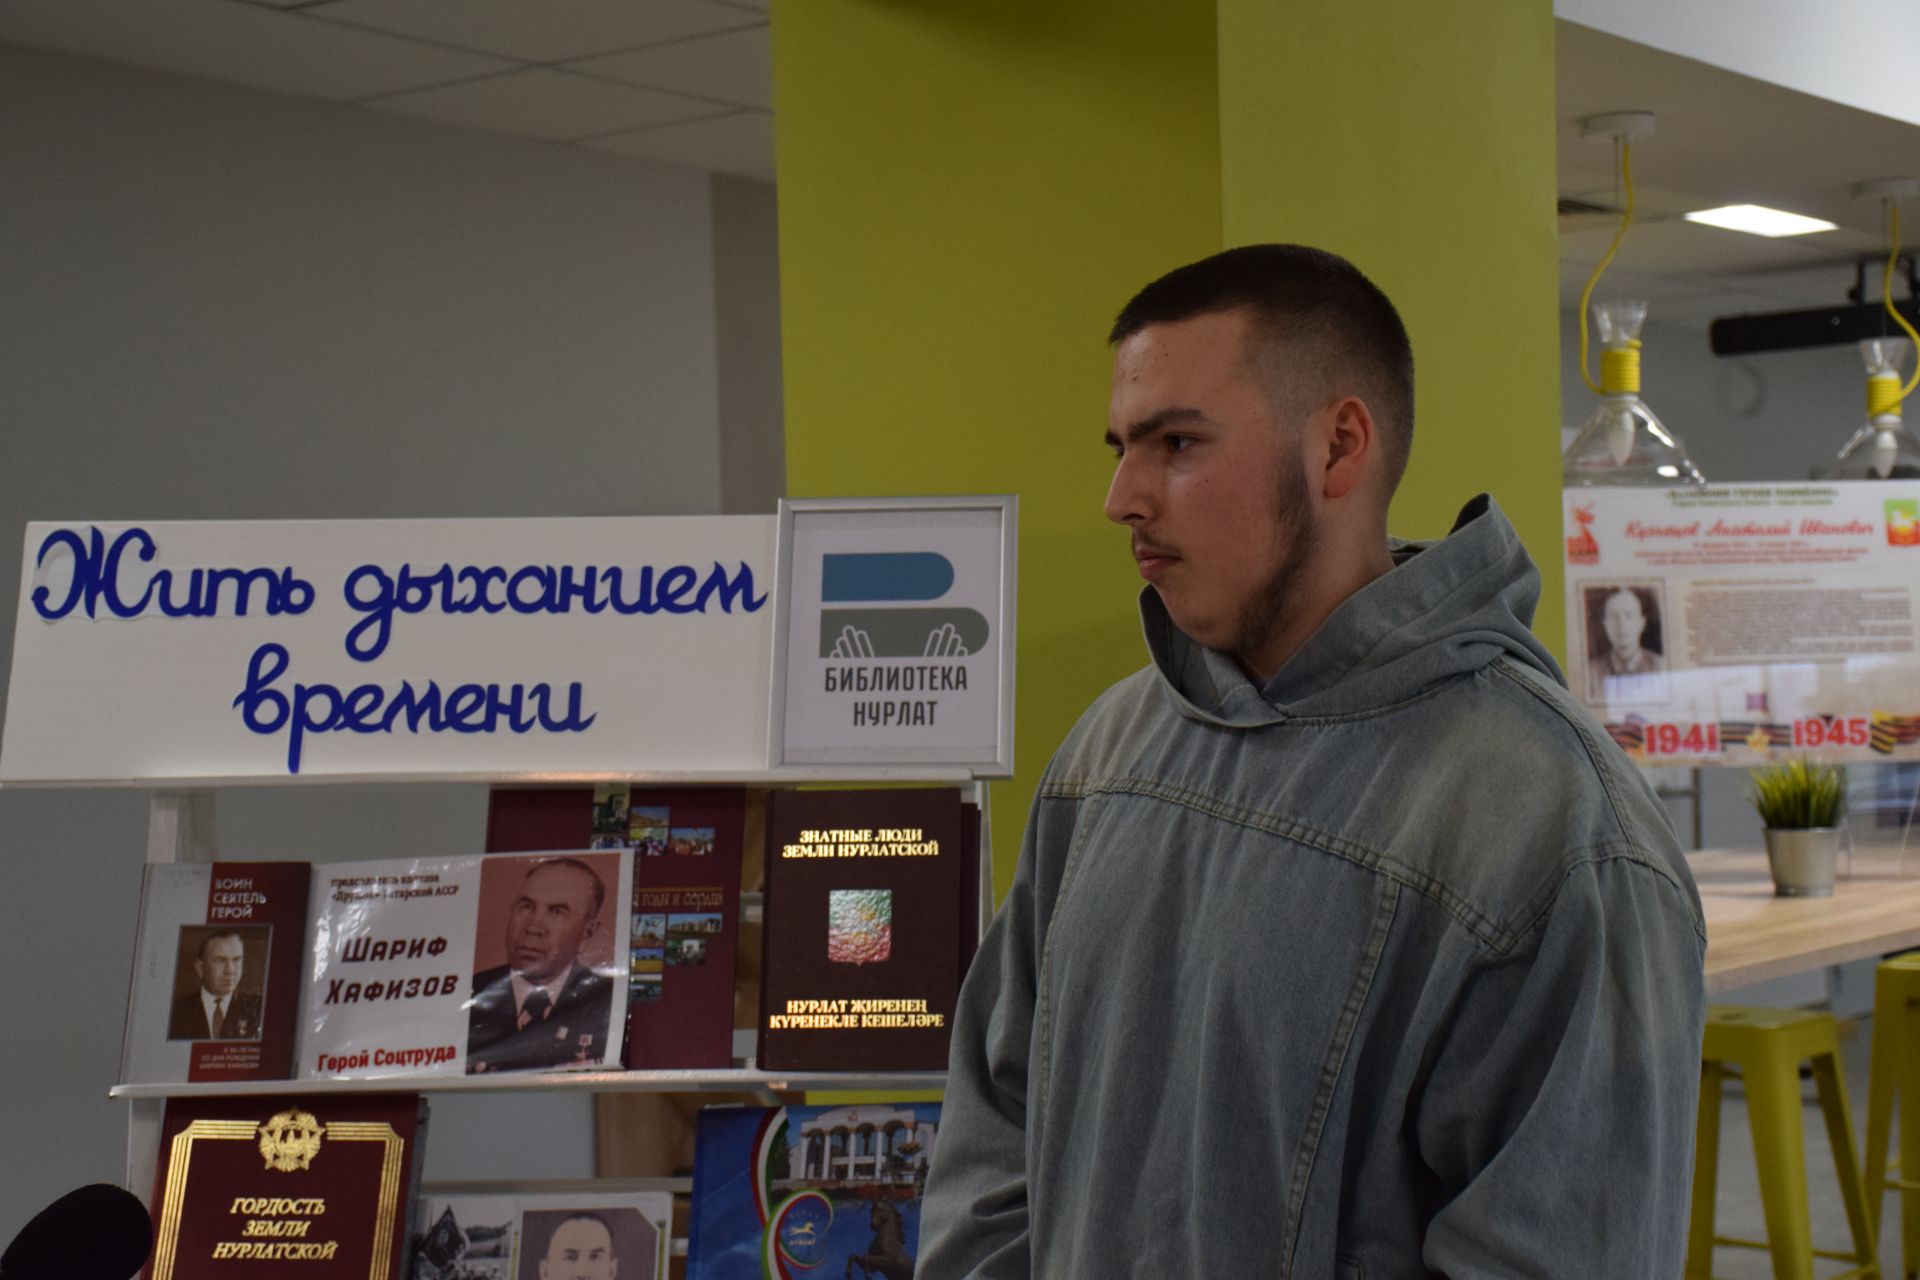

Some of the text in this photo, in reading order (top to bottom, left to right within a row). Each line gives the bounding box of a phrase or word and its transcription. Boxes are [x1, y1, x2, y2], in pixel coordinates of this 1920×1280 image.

[31, 526, 768, 663] Жить дыханием
[826, 667, 967, 691] БИБЛИОТЕКА
[232, 642, 597, 774] времени
[853, 702, 937, 726] НУРЛАТ
[1643, 717, 1871, 754] 1941 1945
[799, 829, 923, 844] ЗНАТНЫЕ ЛЮДИ
[782, 841, 939, 858] ЗЕМЛИ НУРЛАТСКОЙ
[214, 878, 253, 890] ВОИН
[213, 892, 267, 904] СЕЯТЕЛЬ
[383, 887, 432, 901] Ттарской
[211, 904, 253, 919] ГЕРОЙ
[786, 1000, 848, 1013] НУРЛАТ
[861, 1014, 945, 1028] КЕШЕЛӘРЕ
[317, 1044, 458, 1074] Герой Соцтруда
[230, 1198, 326, 1217] ГОРДОСТЬ
[242, 1220, 311, 1237] ЗЕМЛИ
[212, 1240, 338, 1260] НУРЛАТСКОЙ
